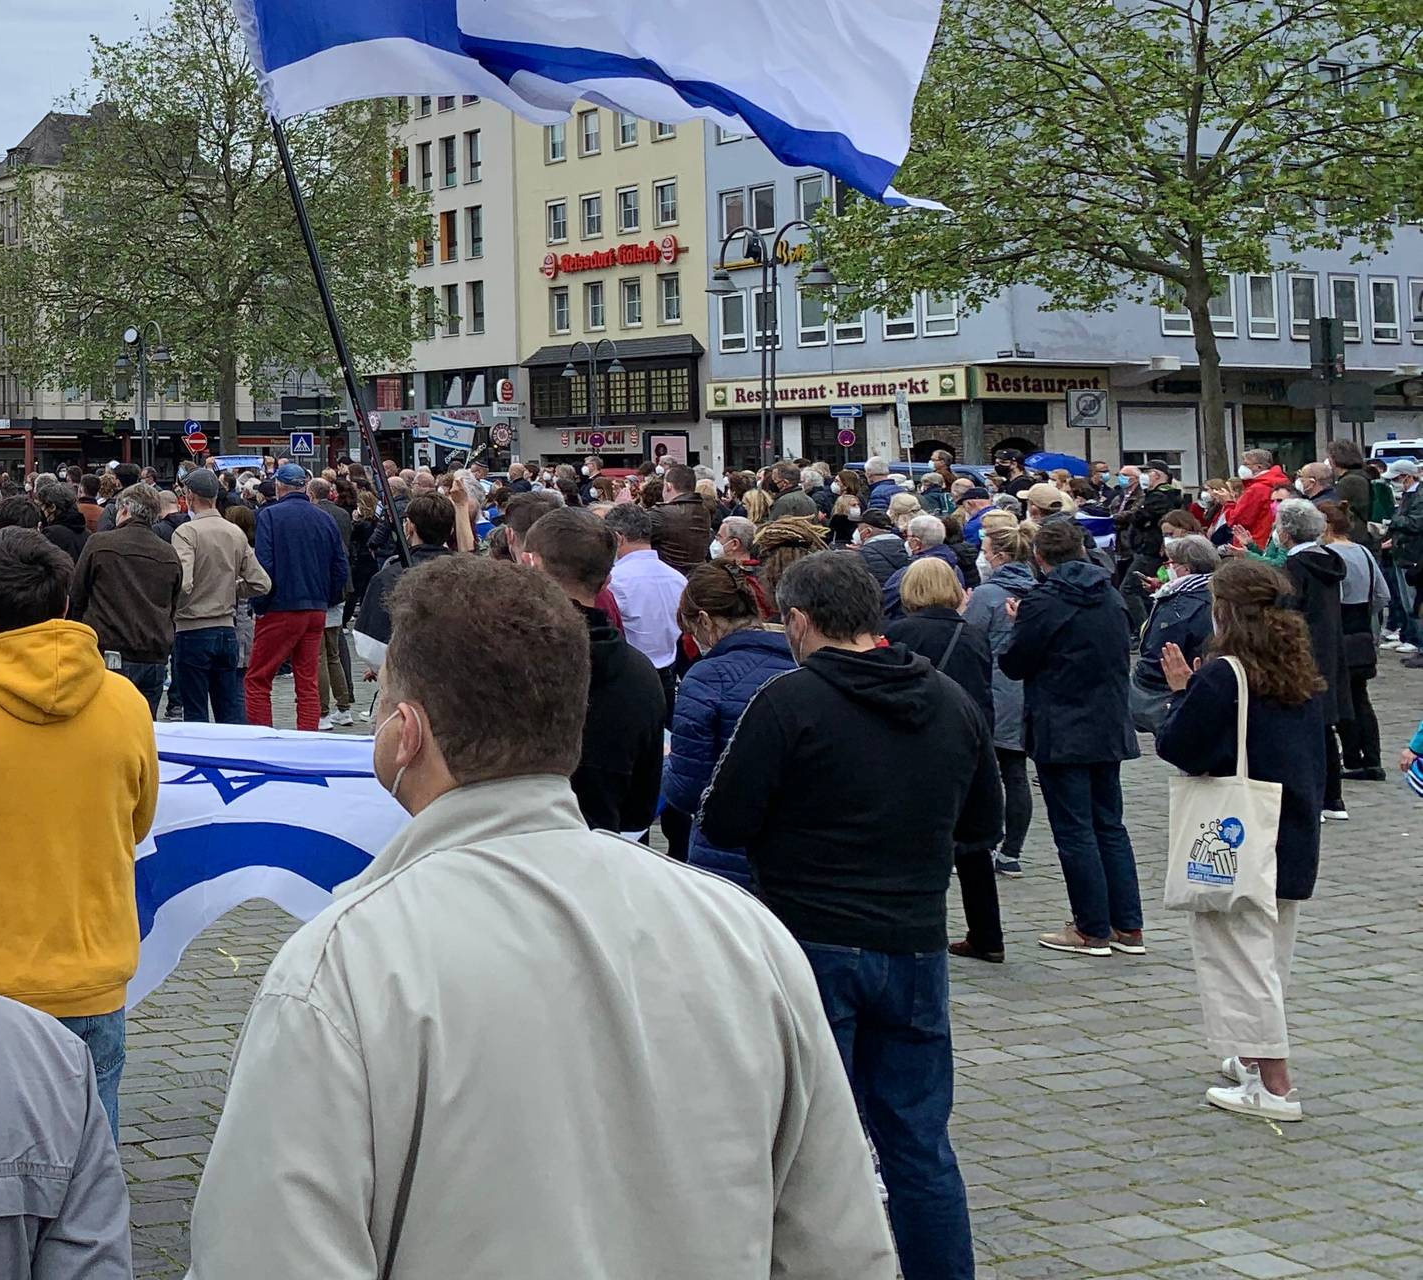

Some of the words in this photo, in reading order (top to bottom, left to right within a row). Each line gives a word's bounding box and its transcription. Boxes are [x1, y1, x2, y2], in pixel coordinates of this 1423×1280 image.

[561, 248, 616, 273] Reissdorf
[617, 240, 660, 265] Kölsch
[735, 384, 826, 404] Restaurant
[837, 376, 929, 398] Heumarkt
[985, 371, 1101, 394] Restaurant
[574, 429, 625, 446] FUCHI
